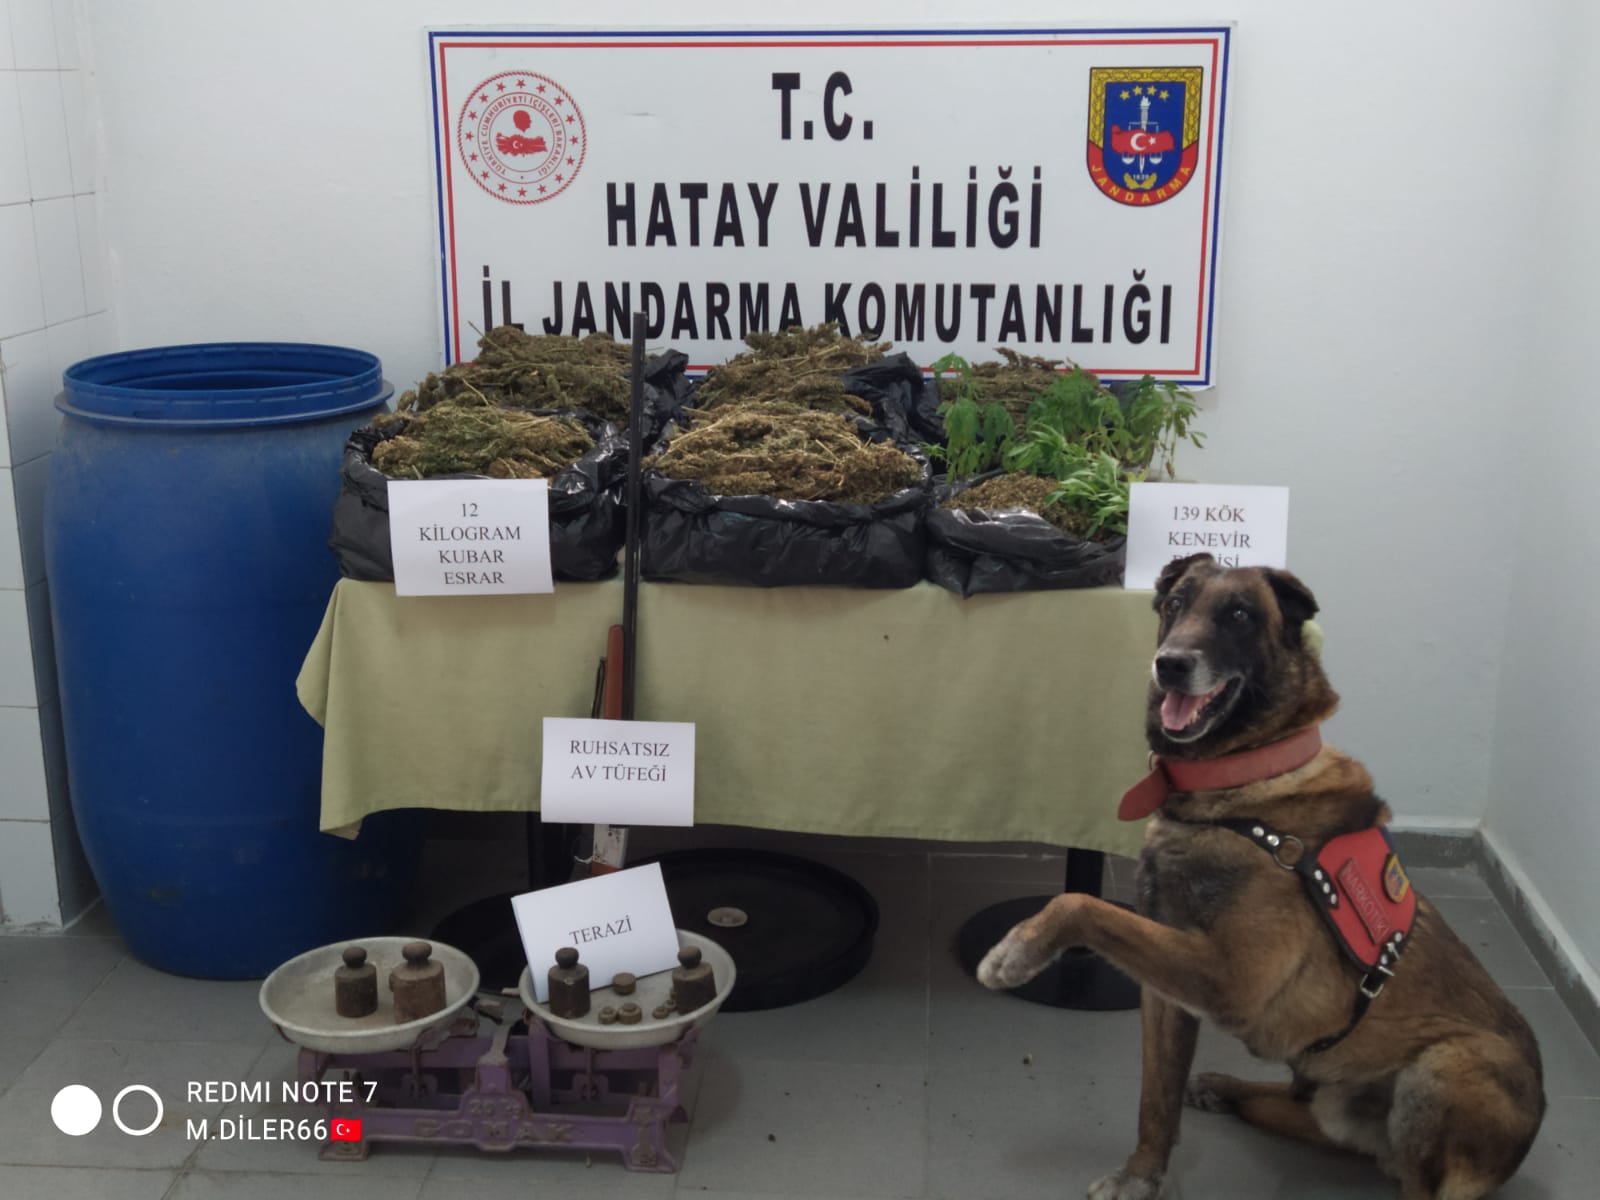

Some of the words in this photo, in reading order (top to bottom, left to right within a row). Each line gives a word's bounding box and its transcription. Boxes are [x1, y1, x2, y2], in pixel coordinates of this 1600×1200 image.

[480, 95, 528, 138] CUMHURİYETİ
[528, 95, 562, 129] İÇİŞLERİ
[771, 71, 874, 141] T.C.
[537, 129, 564, 177] BAKANLIĞI
[1090, 164, 1193, 203] JANDARMA
[606, 181, 779, 247] HATAY
[798, 165, 1043, 249] VALİLİĞİ
[482, 265, 525, 332] İL
[542, 280, 804, 341] JANDARMA
[826, 269, 1173, 344] KOMUTANLIĞI
[462, 503, 479, 518] 12
[1172, 506, 1201, 521] 139
[1205, 504, 1246, 523] KÖK
[419, 523, 522, 542] KİLOGRAM
[1168, 531, 1251, 549] KENEVİR
[438, 549, 505, 565] KUBAR
[443, 570, 506, 585] ESRAR
[570, 739, 671, 758] RUHSATSIZ
[571, 765, 598, 780] AV
[602, 763, 667, 782] TÜFEĞİ
[569, 914, 633, 945] TERAZİ
